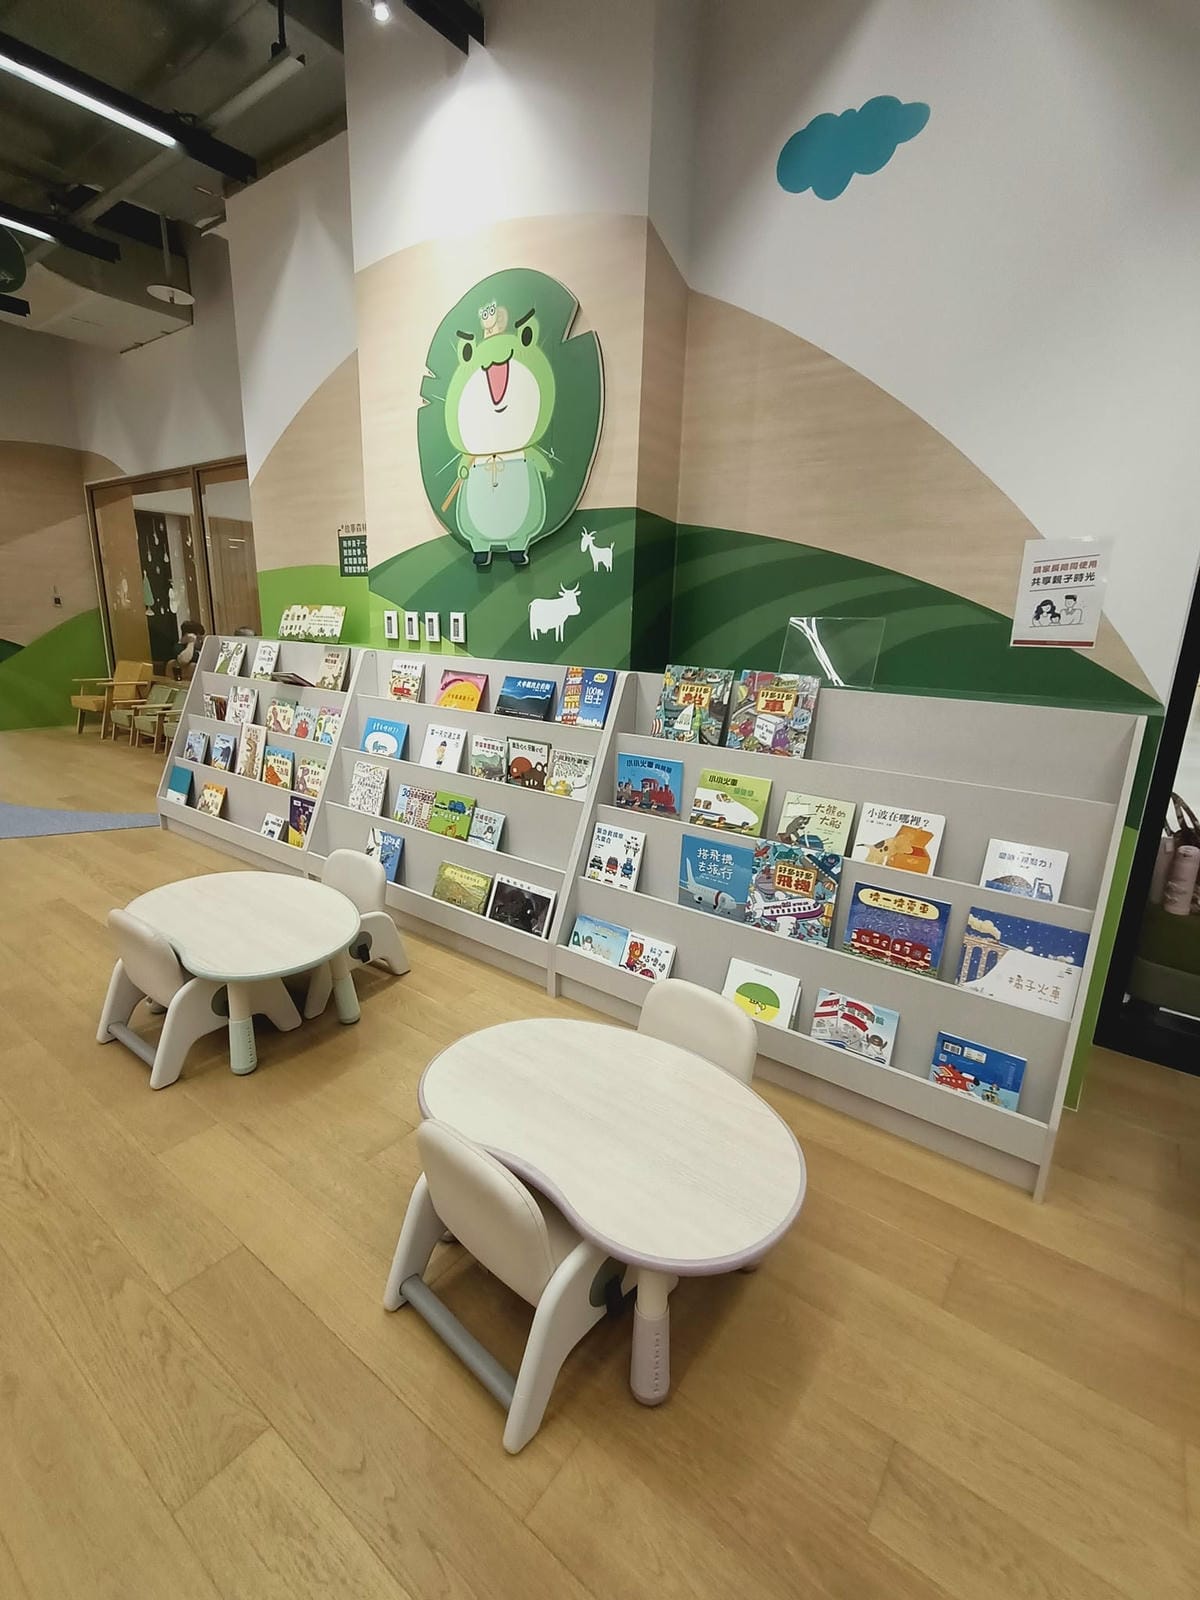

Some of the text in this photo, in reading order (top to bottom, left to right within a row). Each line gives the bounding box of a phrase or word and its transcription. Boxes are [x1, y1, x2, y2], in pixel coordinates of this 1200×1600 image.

[1031, 572, 1096, 586] 共享親子時光
[815, 804, 847, 818] 大熊的
[697, 848, 735, 866] 搭飛機
[698, 861, 734, 880] 去旅行
[776, 874, 811, 893] 飛機
[1008, 974, 1062, 1001] 橘子火車
